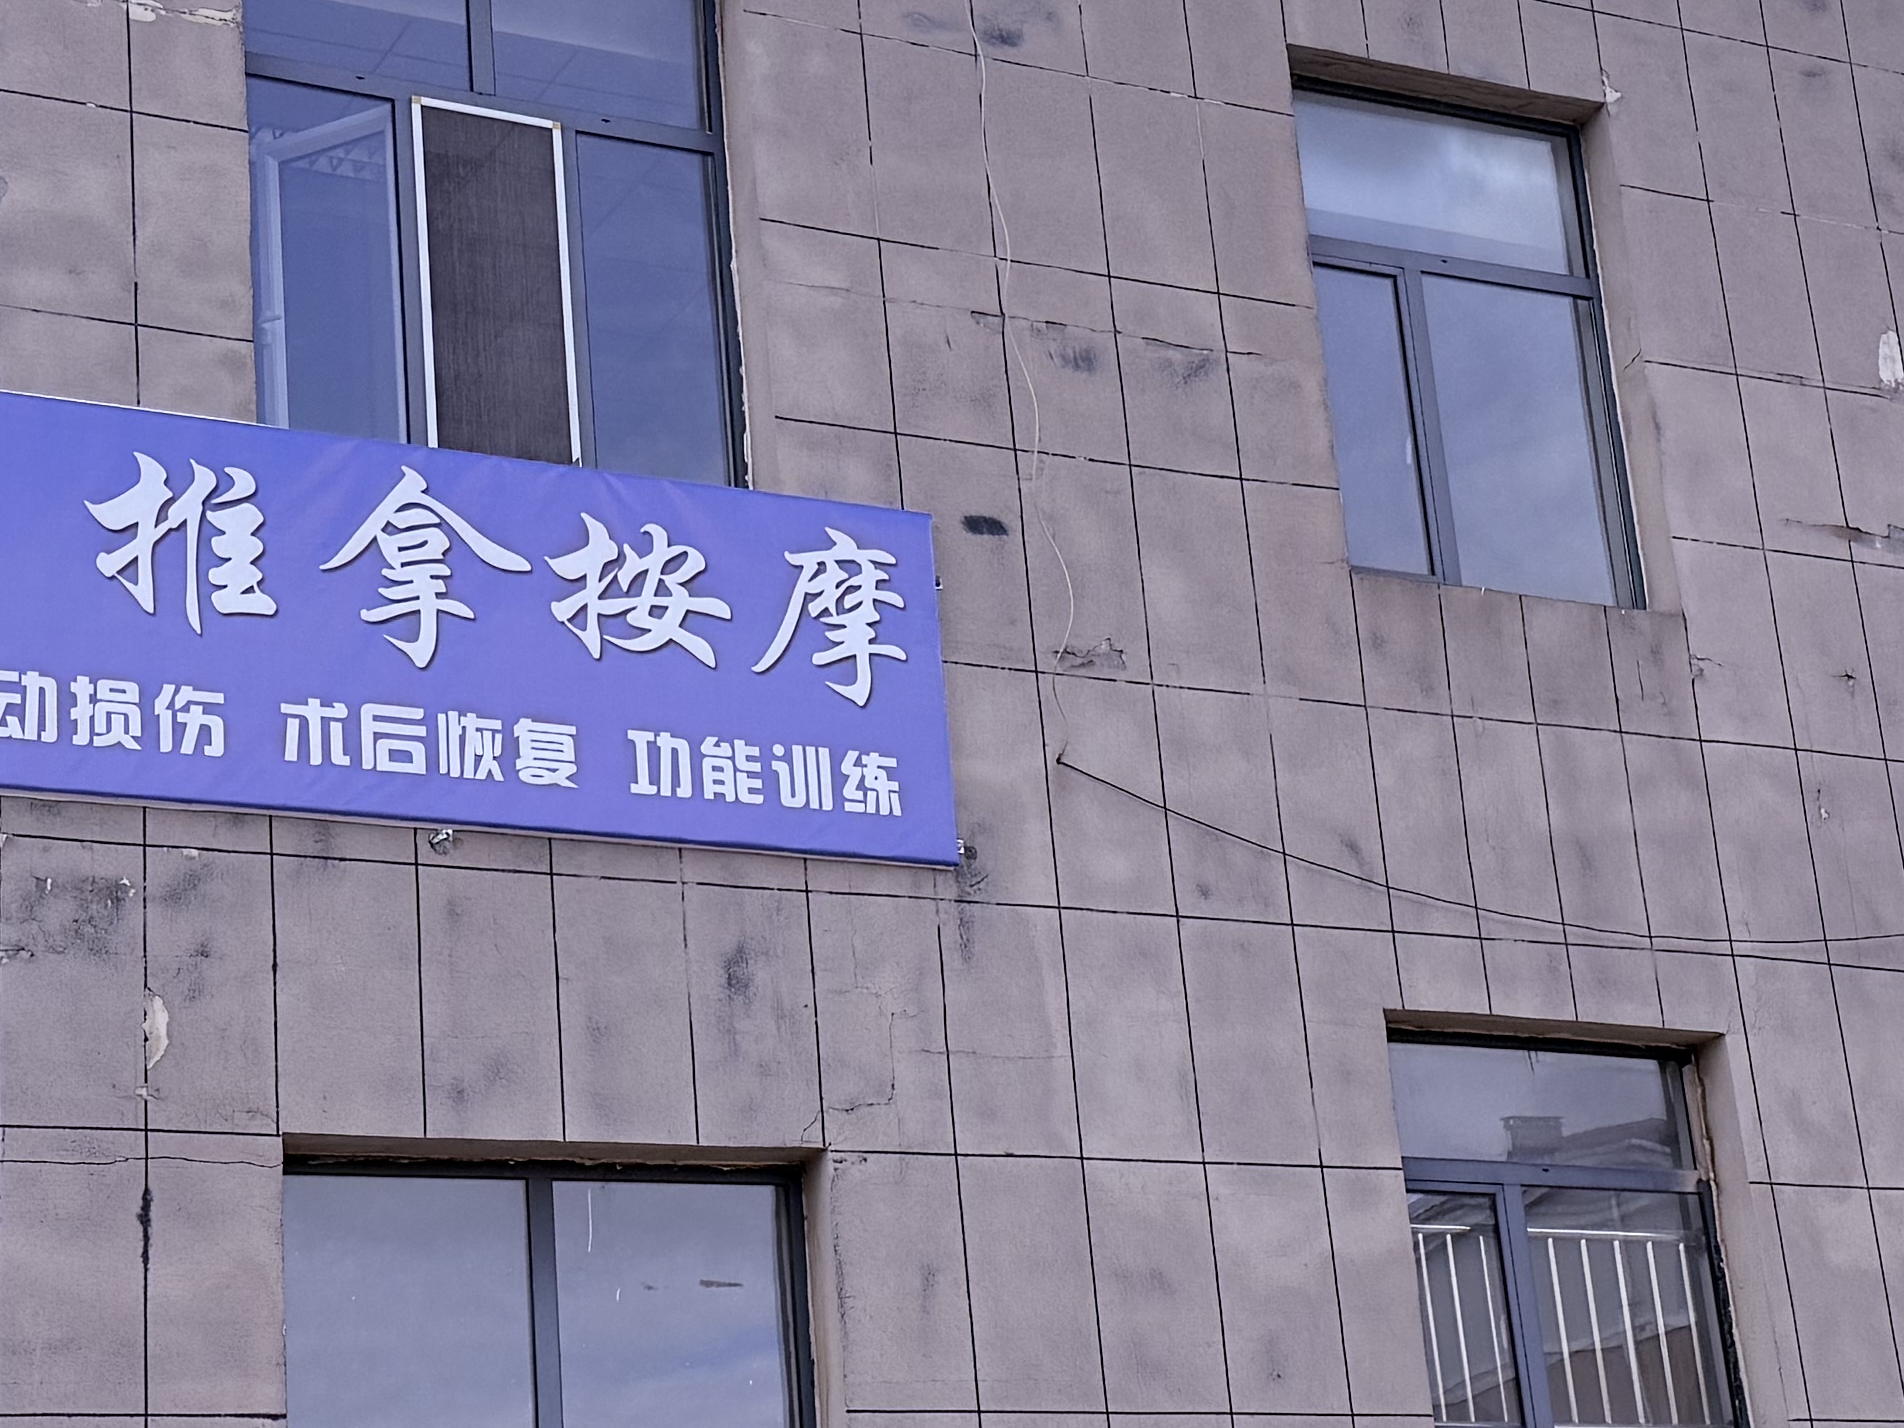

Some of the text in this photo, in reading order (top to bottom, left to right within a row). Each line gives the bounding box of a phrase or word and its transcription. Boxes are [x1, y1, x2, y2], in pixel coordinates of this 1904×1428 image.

[82, 451, 908, 708] 推拿按摩
[279, 697, 579, 789] 术后恢复
[626, 728, 904, 817] 功能训练
